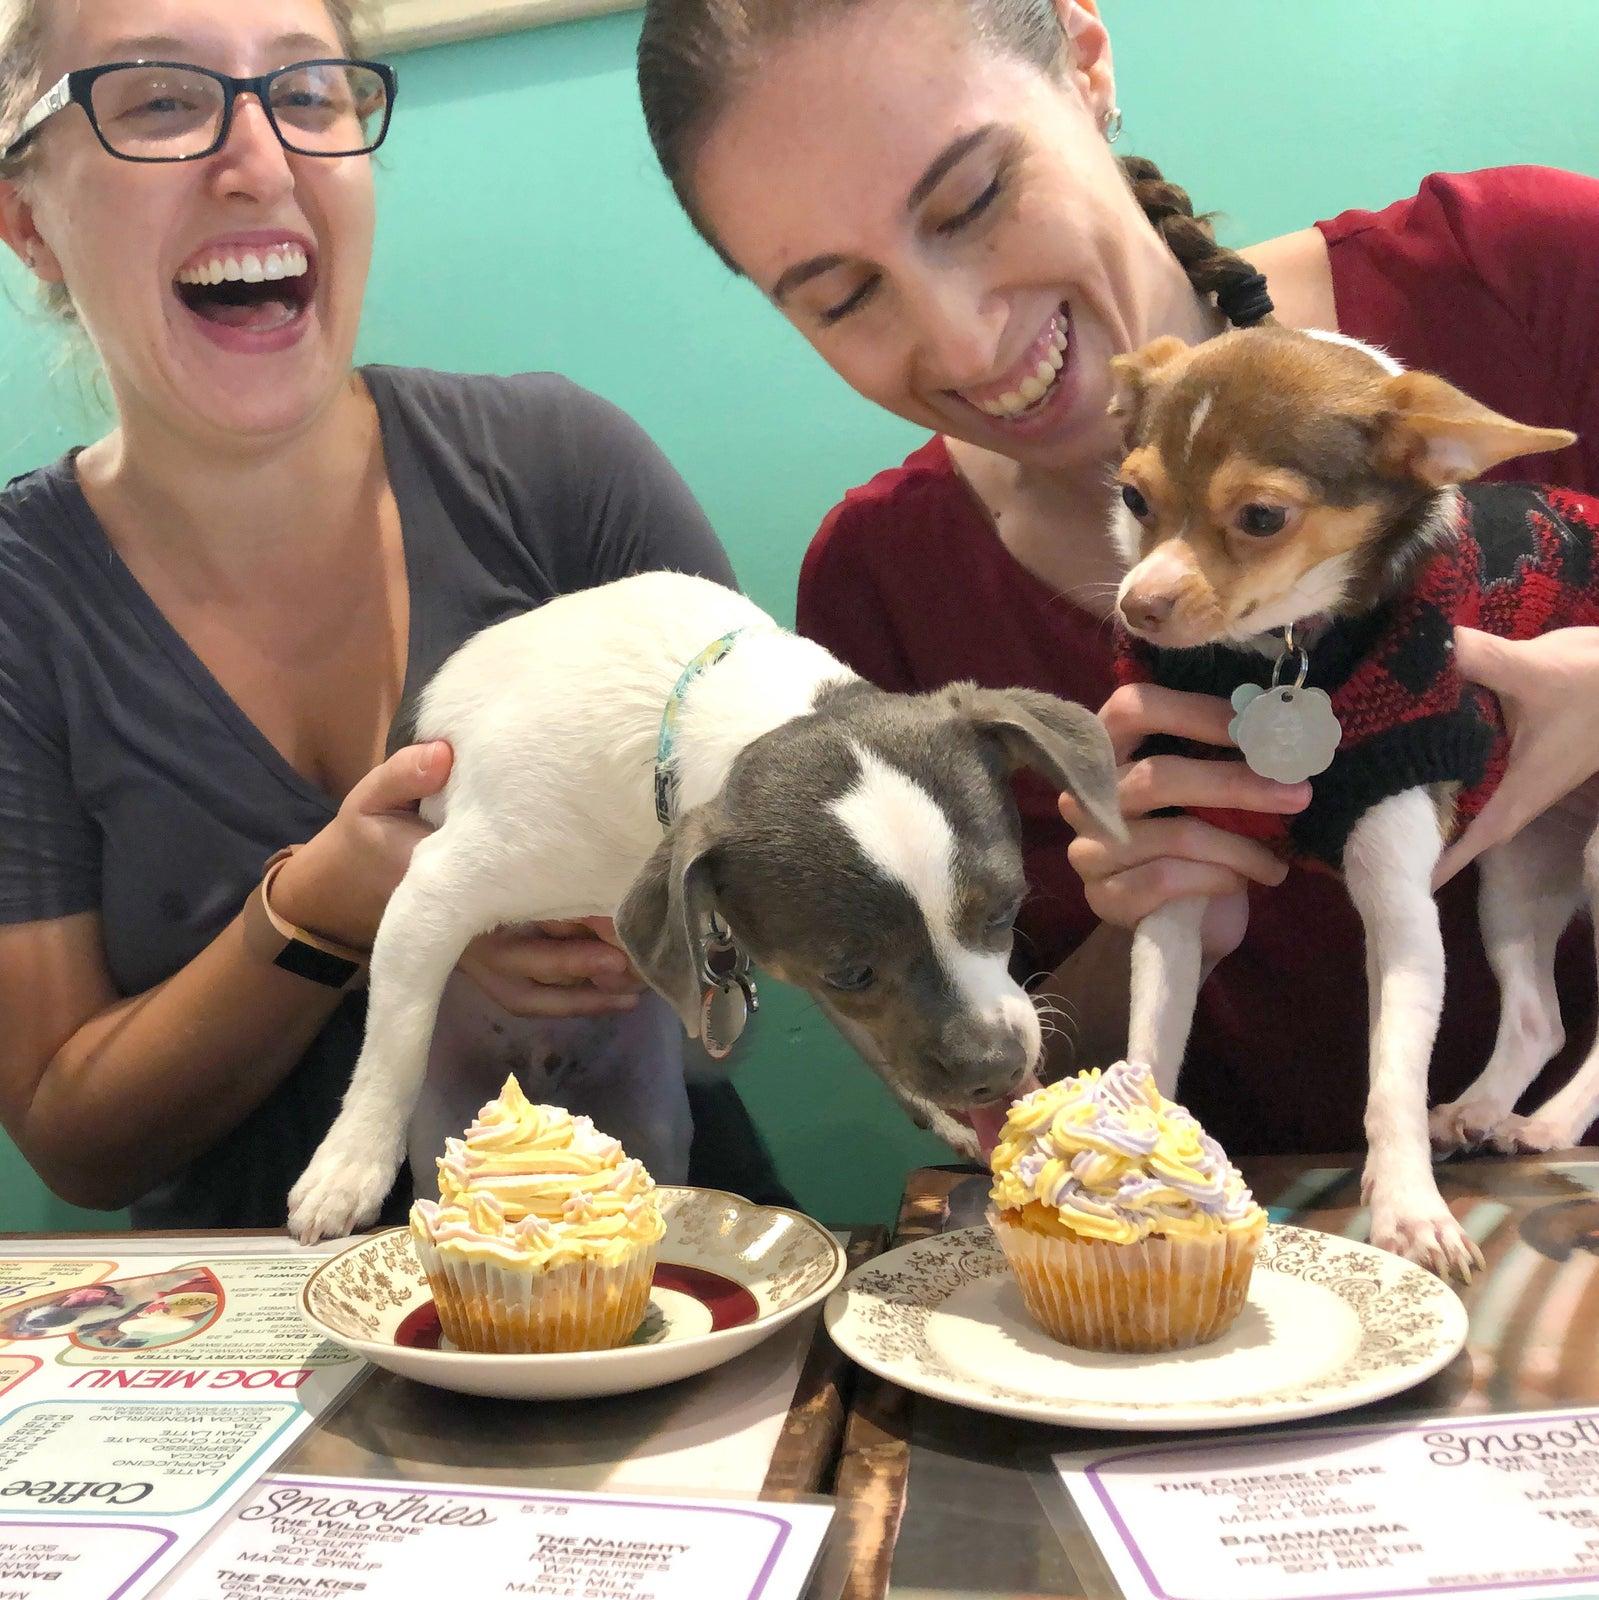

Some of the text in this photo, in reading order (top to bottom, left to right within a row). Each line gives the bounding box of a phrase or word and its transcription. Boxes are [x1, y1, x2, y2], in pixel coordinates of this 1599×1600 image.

[67, 1369, 315, 1389] DOG MENU
[112, 1460, 226, 1468] CAPPUCCINO
[1153, 1466, 1386, 1492] THE CHEESE CAKE
[1, 1480, 154, 1504] Coffee
[238, 1488, 498, 1527] Smoothies
[271, 1516, 423, 1535] THE WILD ONE
[1219, 1511, 1293, 1525] MAPLE
[271, 1525, 404, 1543] WILD BERRIES
[291, 1536, 369, 1549] YOGURT
[536, 1532, 691, 1553] THE NAUGHTY
[271, 1544, 365, 1559] SOY MILK
[538, 1544, 673, 1561] RASPBERRY
[1236, 1550, 1324, 1566] PEANUT
[236, 1551, 383, 1571] MAPLE SYRUP
[529, 1552, 671, 1571] RASPBERRIES
[216, 1569, 367, 1591] THE SUN KISS
[505, 1581, 575, 1596] MAPLE
[535, 1573, 637, 1590] SOY MILK
[220, 1581, 345, 1598] GRAPEFRUIT
